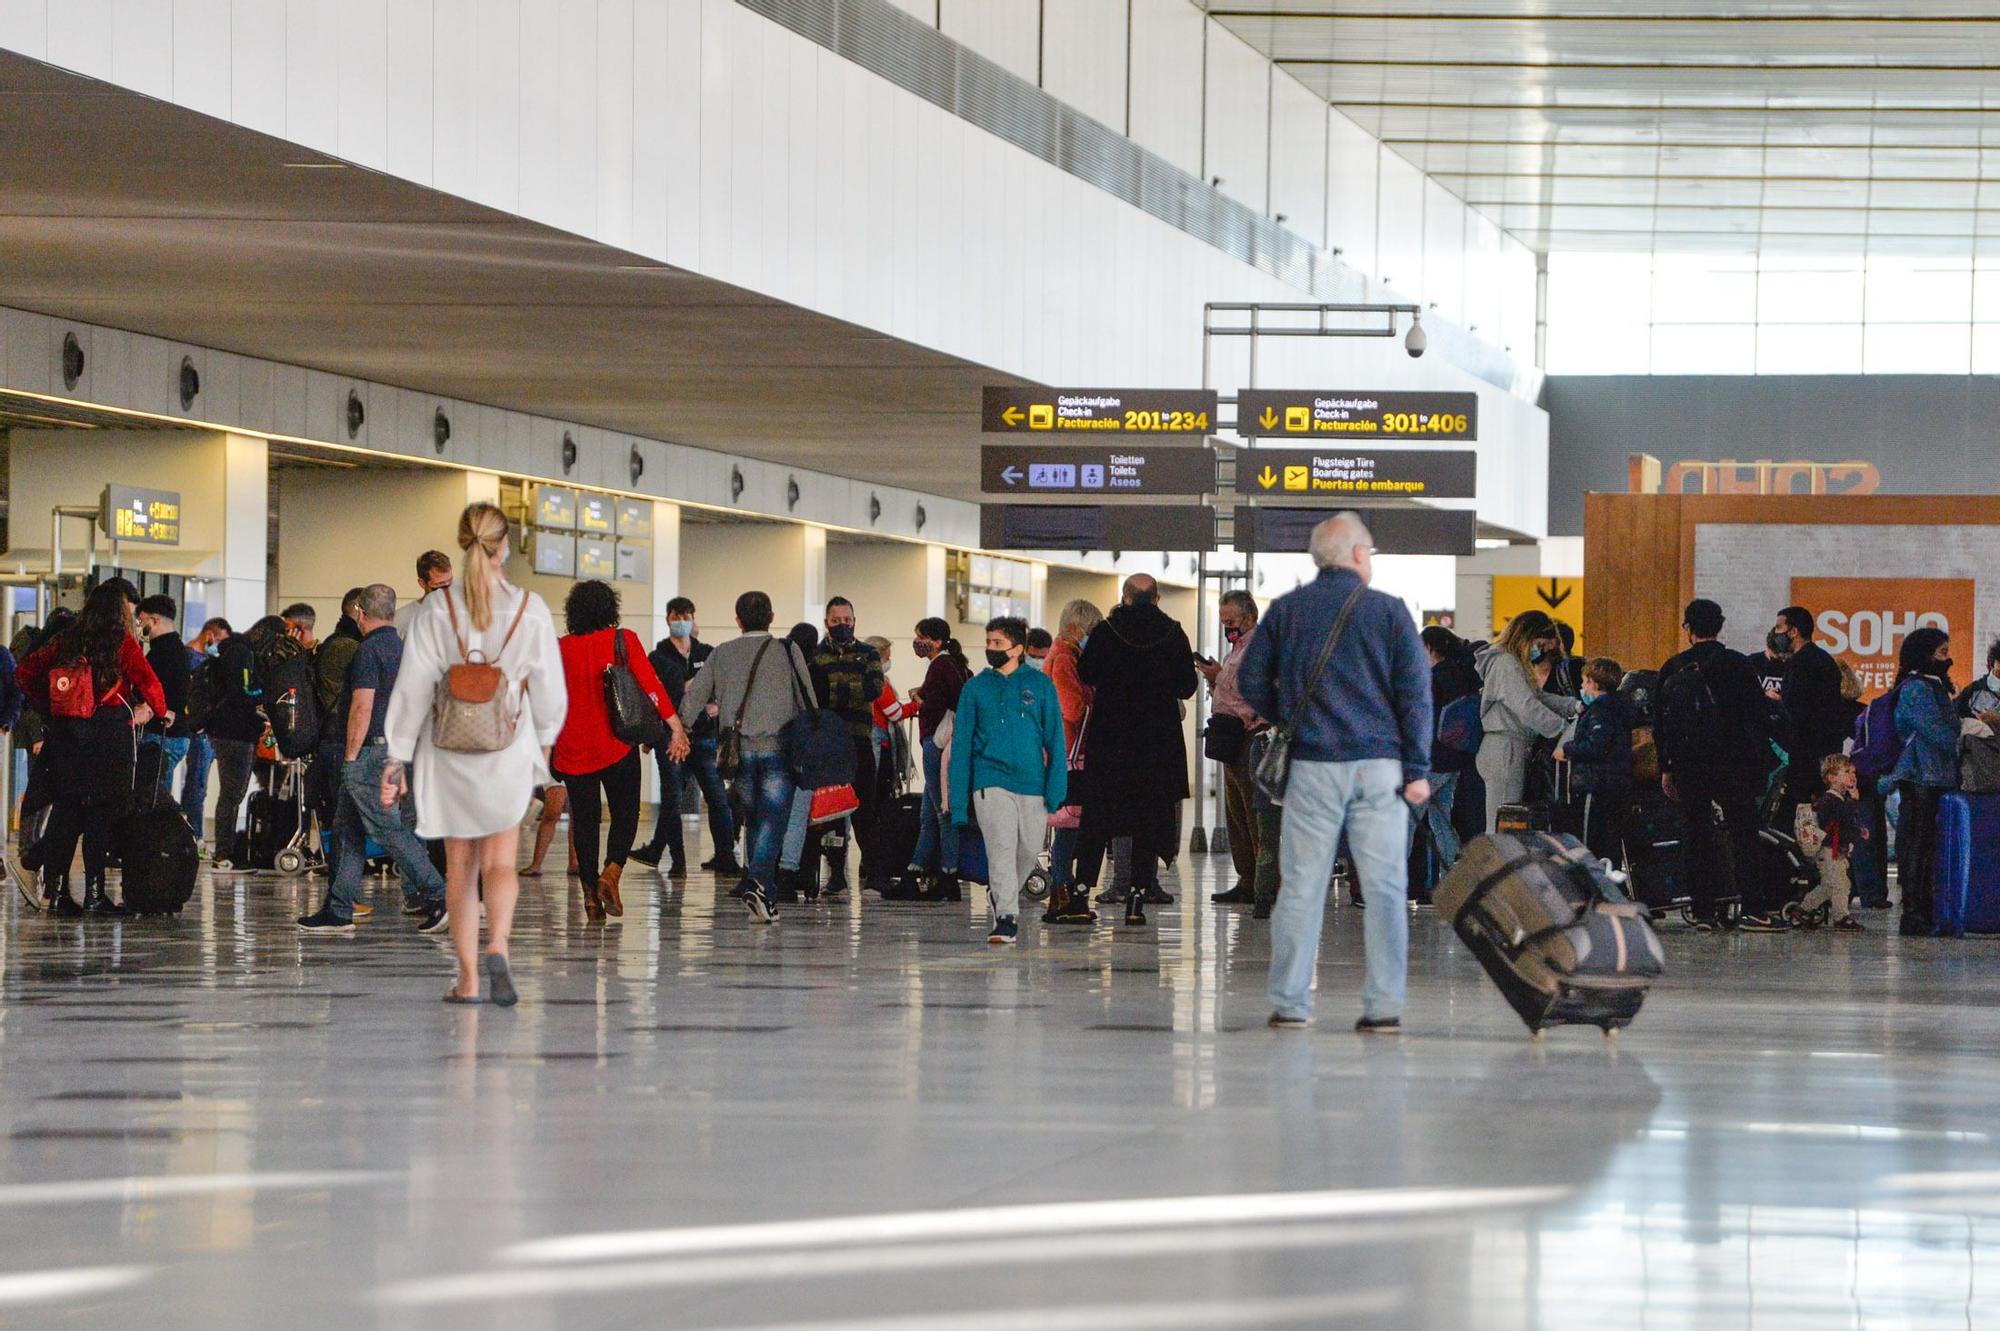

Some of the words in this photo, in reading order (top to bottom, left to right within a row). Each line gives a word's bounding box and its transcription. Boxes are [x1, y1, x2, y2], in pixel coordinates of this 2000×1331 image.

[1058, 395, 1121, 408] Gepäckaufgabe
[1314, 398, 1378, 411] Gepäckaufgabe
[1058, 406, 1093, 417] Check-in
[1314, 409, 1350, 419] Check-in
[1057, 417, 1121, 430] Facturación
[1125, 411, 1161, 430] 201
[1169, 411, 1208, 430] 234
[1313, 419, 1378, 432] Facturación
[1382, 413, 1419, 433] 301
[1427, 413, 1468, 433] 406
[1109, 454, 1145, 465] Toiletten
[1313, 457, 1355, 469] Flugsteige
[1357, 457, 1375, 468] Türe
[1109, 465, 1137, 476] Toilets
[1313, 467, 1349, 480] Boarding
[1350, 468, 1374, 480] gates
[1109, 476, 1142, 488] Aseos
[1313, 479, 1354, 490] Puertas
[1355, 479, 1369, 490] de
[1370, 480, 1425, 492] embarque
